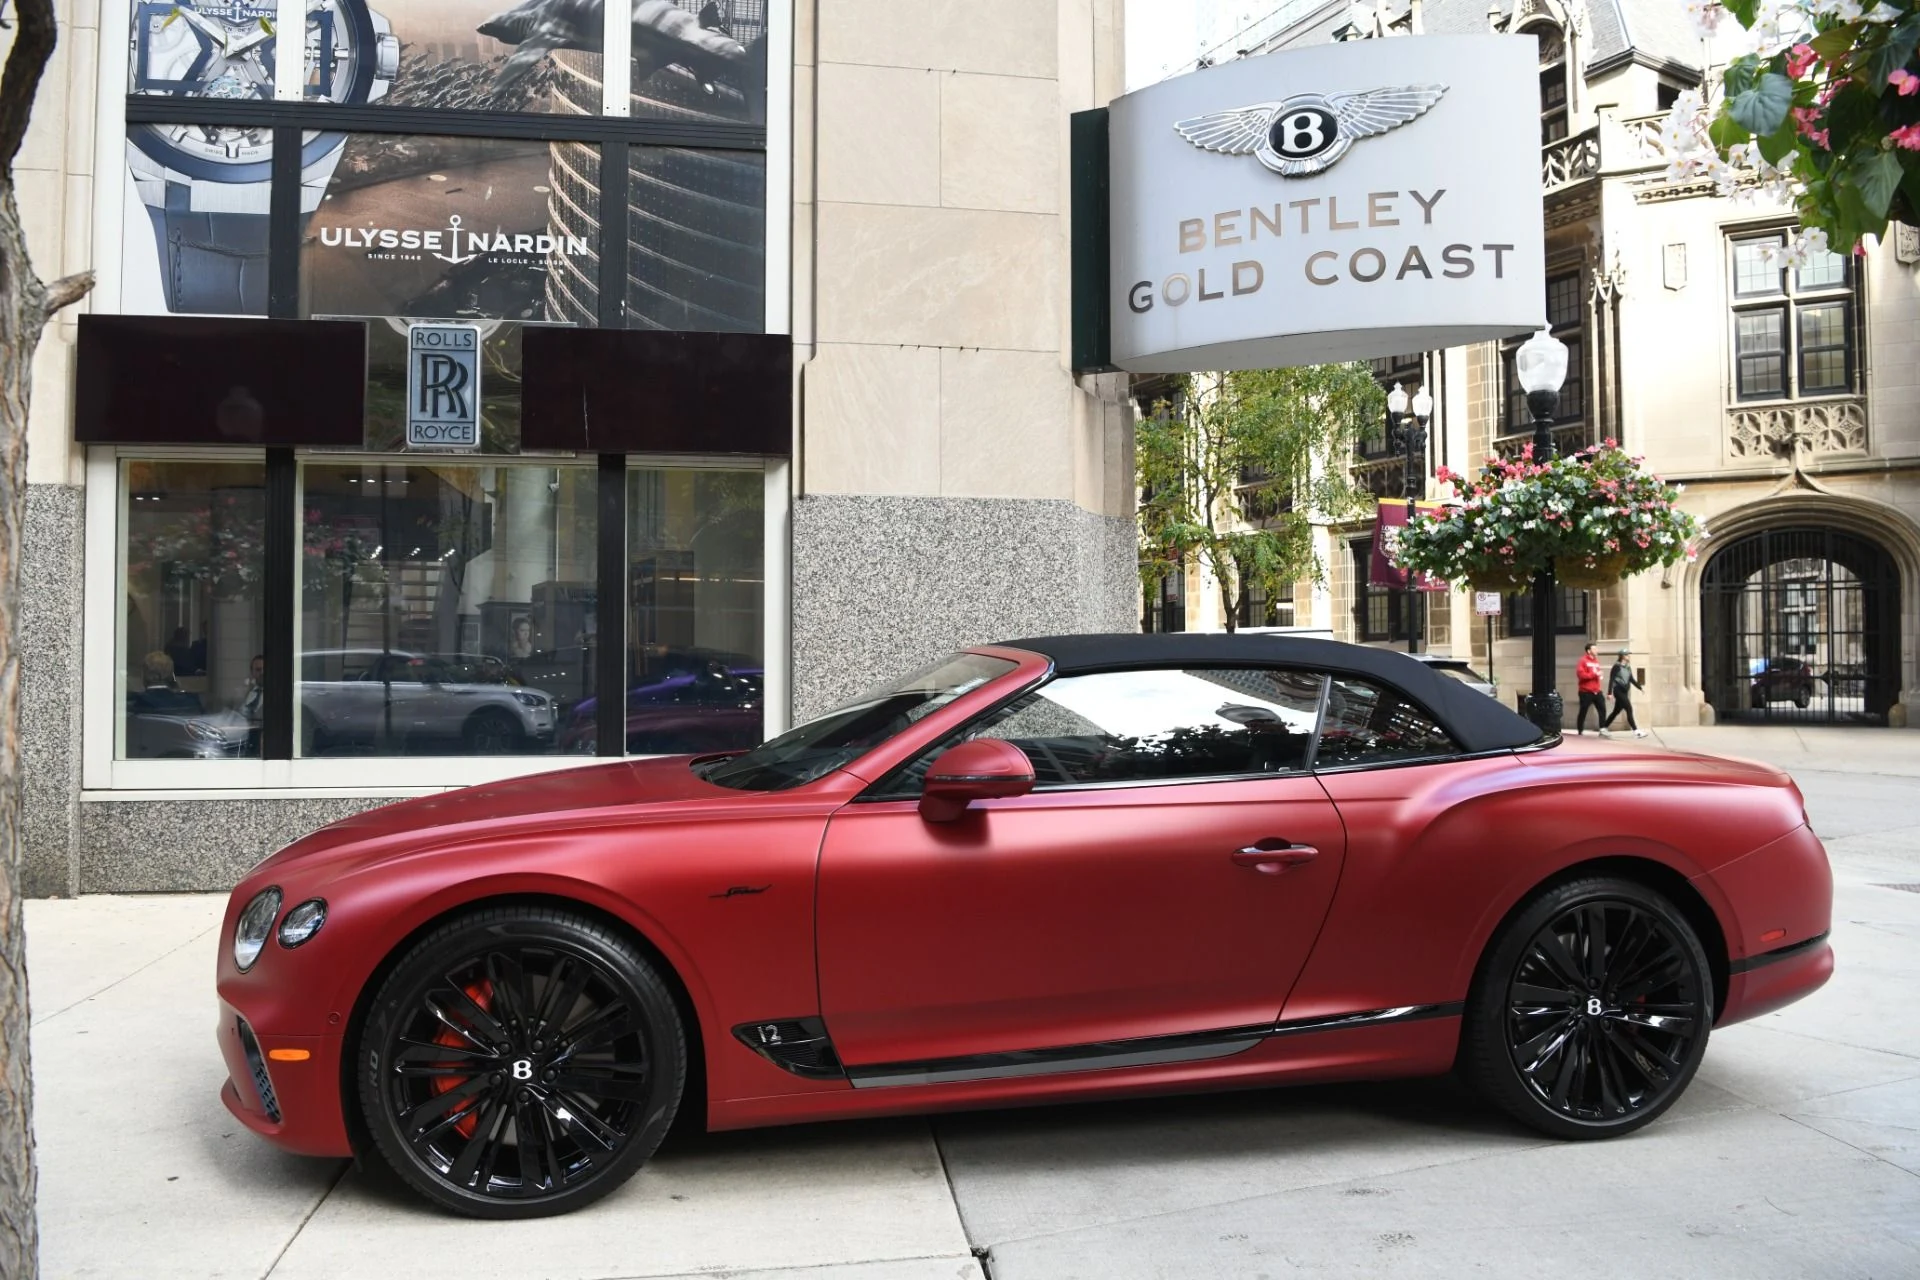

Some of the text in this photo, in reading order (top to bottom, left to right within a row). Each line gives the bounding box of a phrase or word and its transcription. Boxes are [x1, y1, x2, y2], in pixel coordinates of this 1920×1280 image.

[1281, 111, 1324, 153] B
[1179, 189, 1447, 254] BENTLEY
[320, 227, 587, 256] ULYSSE NARDIN
[1128, 243, 1514, 314] GOLD COAST
[416, 332, 472, 347] ROLLS
[414, 425, 471, 440] ROYCE
[1587, 998, 1602, 1016] B
[513, 1060, 532, 1080] B
